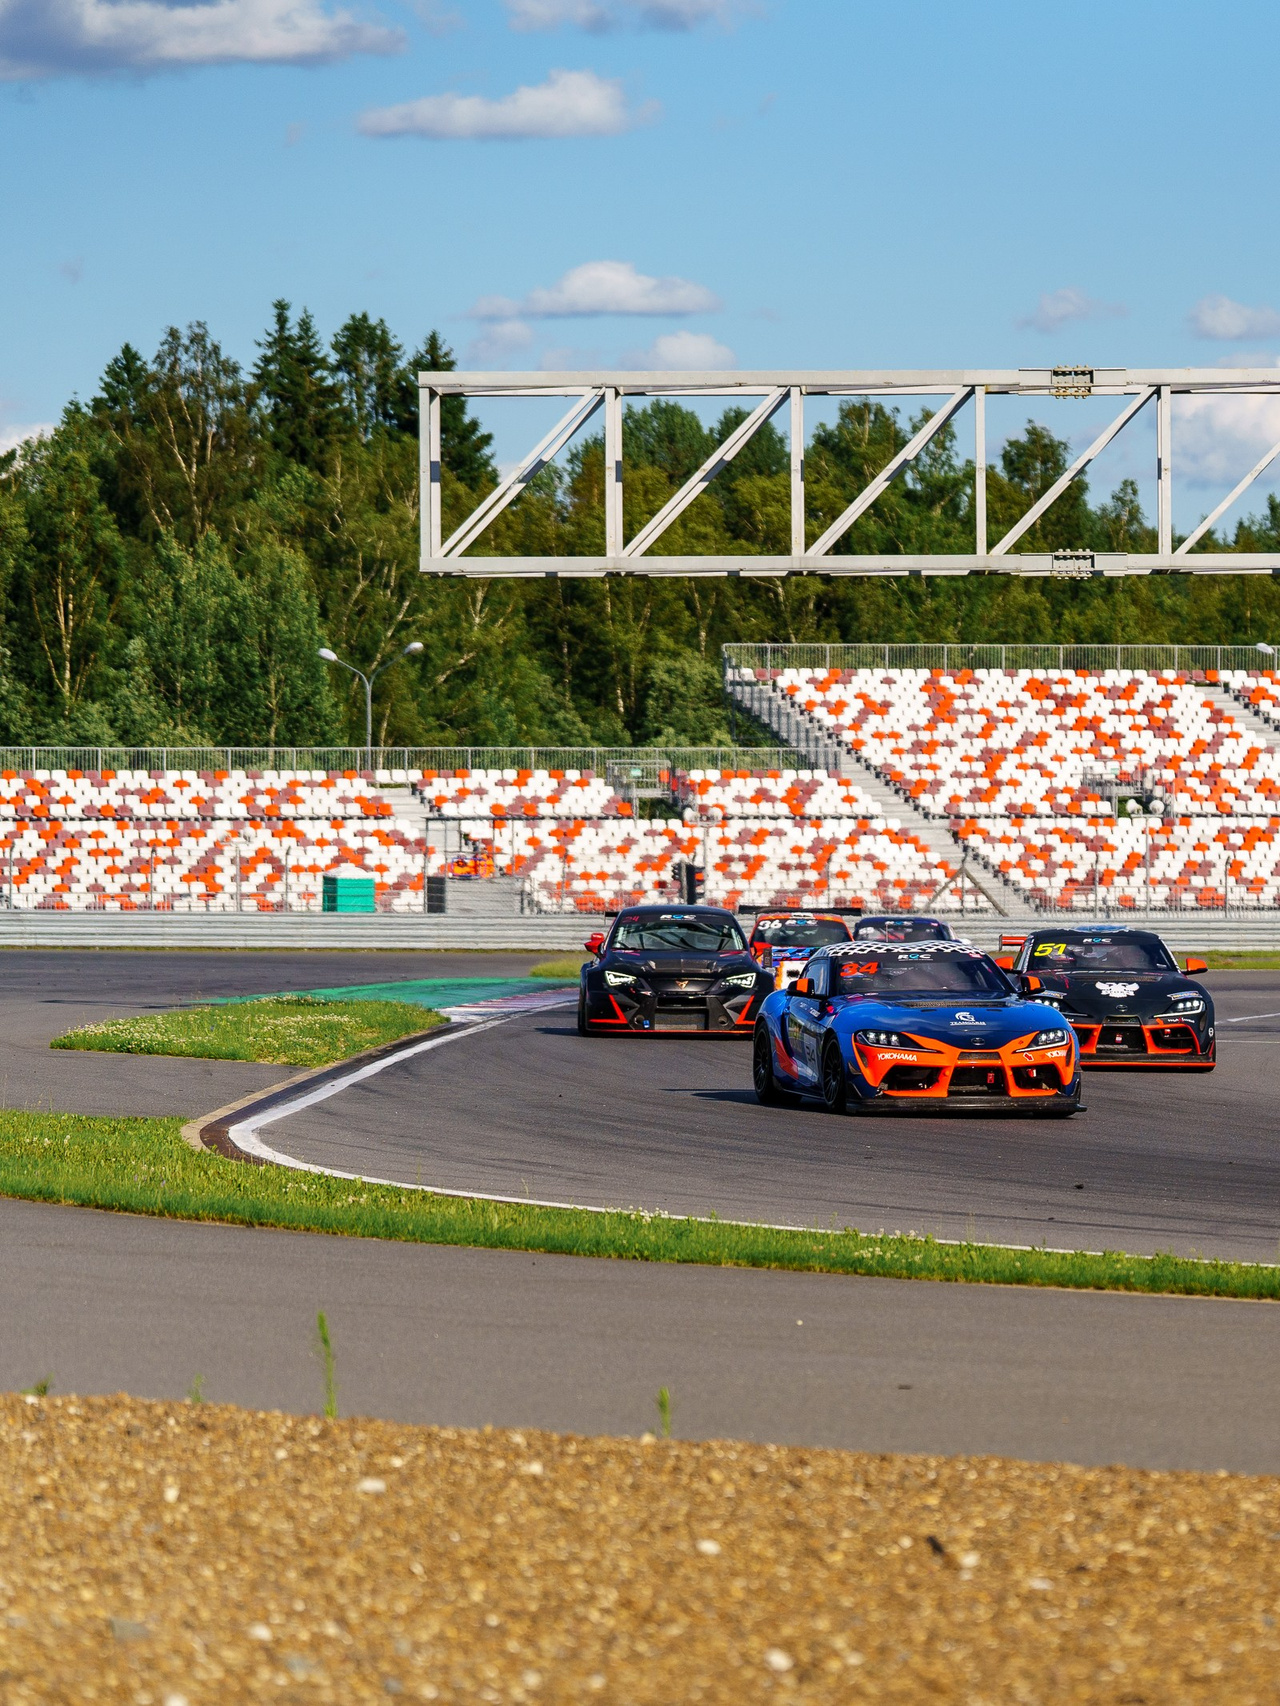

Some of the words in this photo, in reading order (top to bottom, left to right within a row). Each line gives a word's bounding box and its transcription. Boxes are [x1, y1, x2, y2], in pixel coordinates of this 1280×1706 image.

[758, 920, 783, 930] 36
[1034, 943, 1067, 957] 51
[840, 962, 878, 976] 34
[877, 1052, 918, 1062] YOKOHAMA
